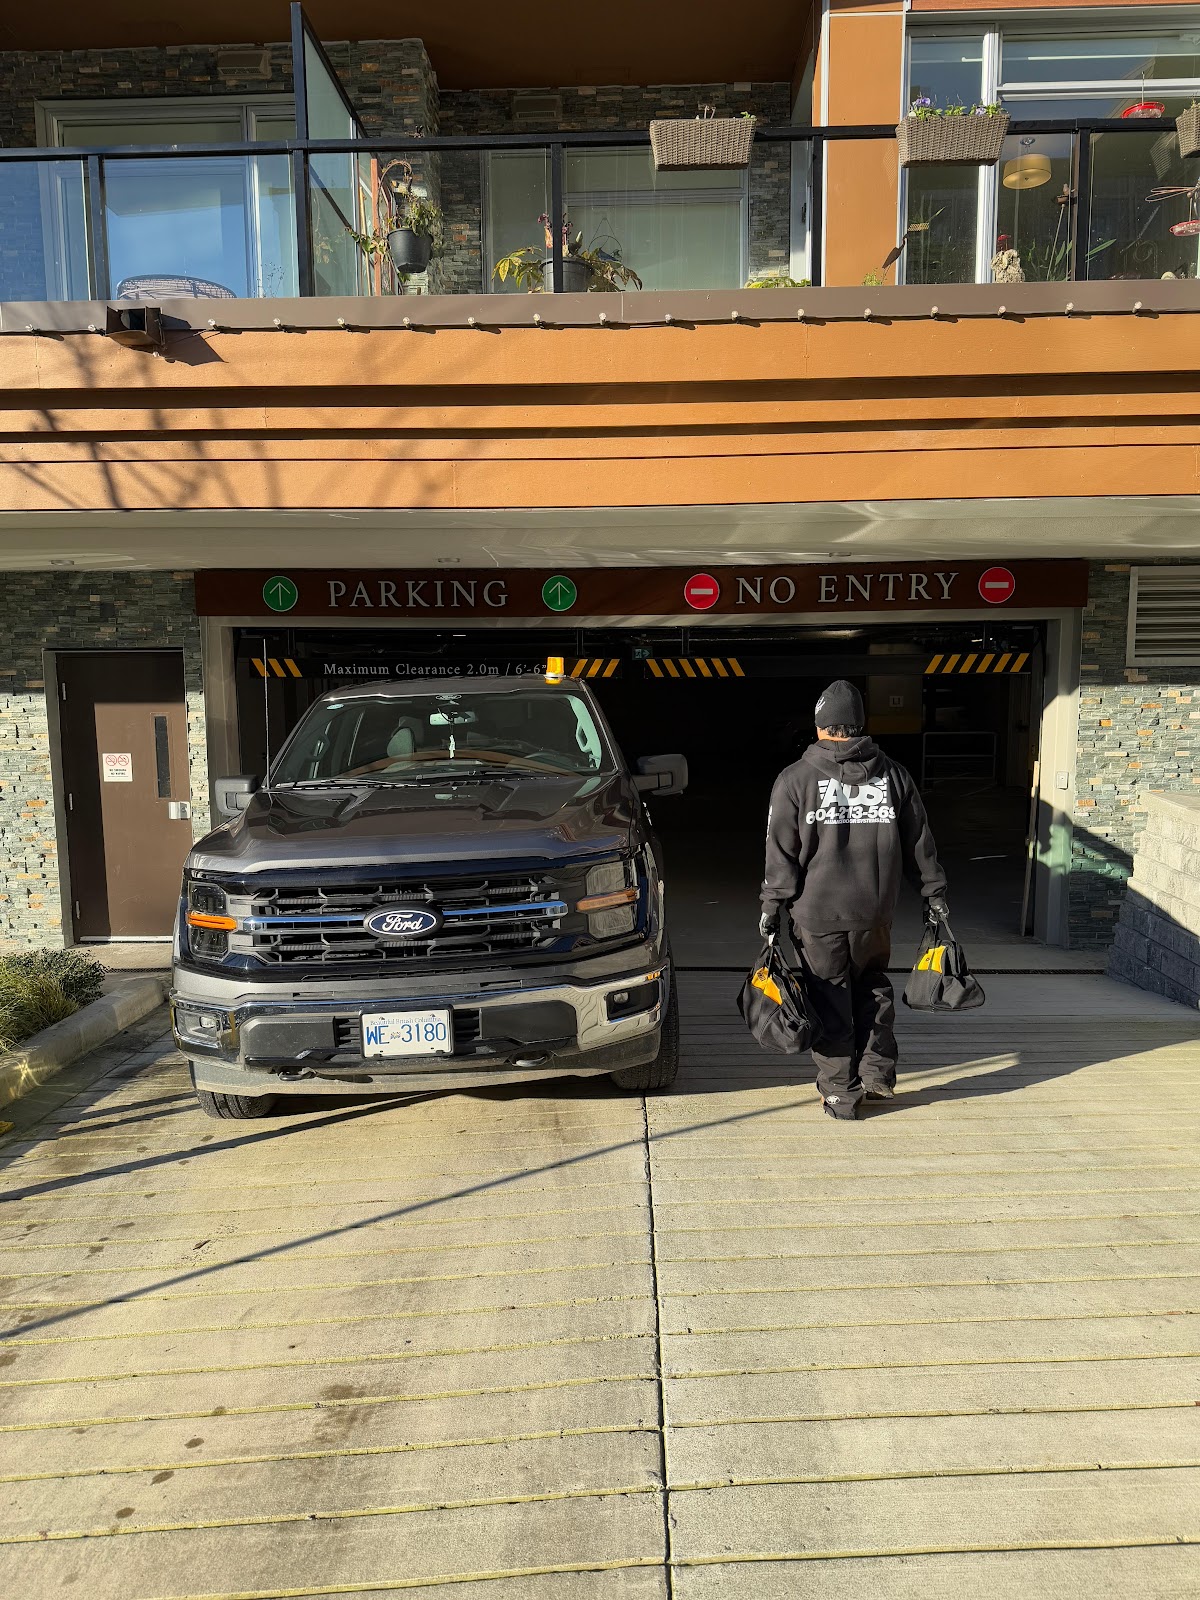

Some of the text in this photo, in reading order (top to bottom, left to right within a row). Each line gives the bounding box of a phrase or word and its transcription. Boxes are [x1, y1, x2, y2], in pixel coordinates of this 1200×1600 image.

[327, 580, 508, 607] PARKING
[735, 572, 959, 604] NO ENTRY
[323, 663, 389, 675] Maximum
[395, 663, 461, 675] Clearance
[466, 663, 500, 675] 2.0m
[505, 663, 511, 676] /
[382, 914, 424, 931] Ford
[366, 1022, 447, 1045] WE 3180
